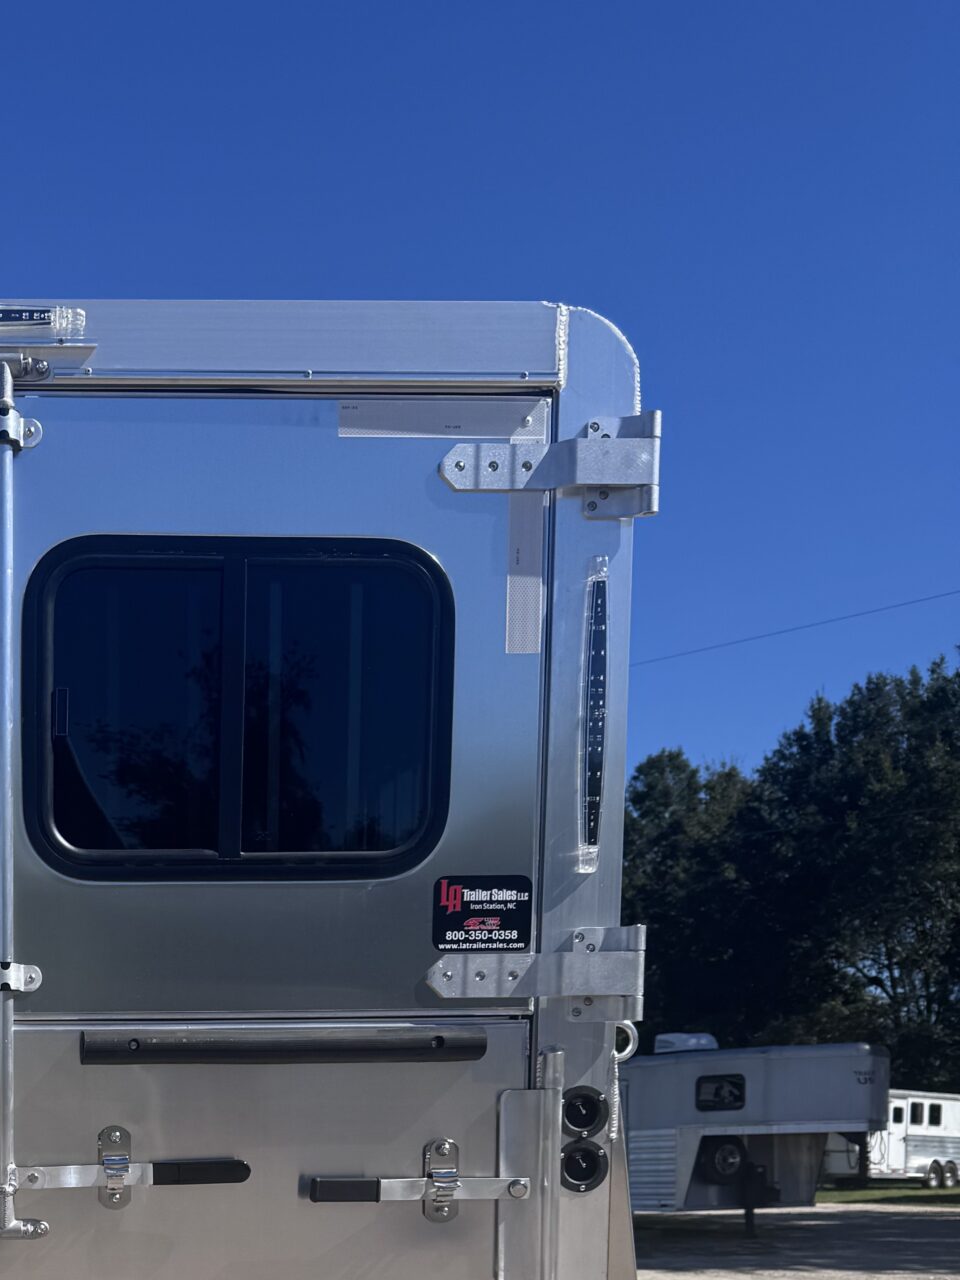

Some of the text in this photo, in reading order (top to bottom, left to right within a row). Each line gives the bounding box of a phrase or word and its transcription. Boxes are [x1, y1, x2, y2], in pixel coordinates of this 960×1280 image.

[462, 889, 491, 901] Trailer
[492, 889, 517, 901] Sales
[483, 903, 506, 911] Station,
[445, 931, 518, 940] 800-350-0358
[438, 941, 525, 949] www.latrailersales.com
